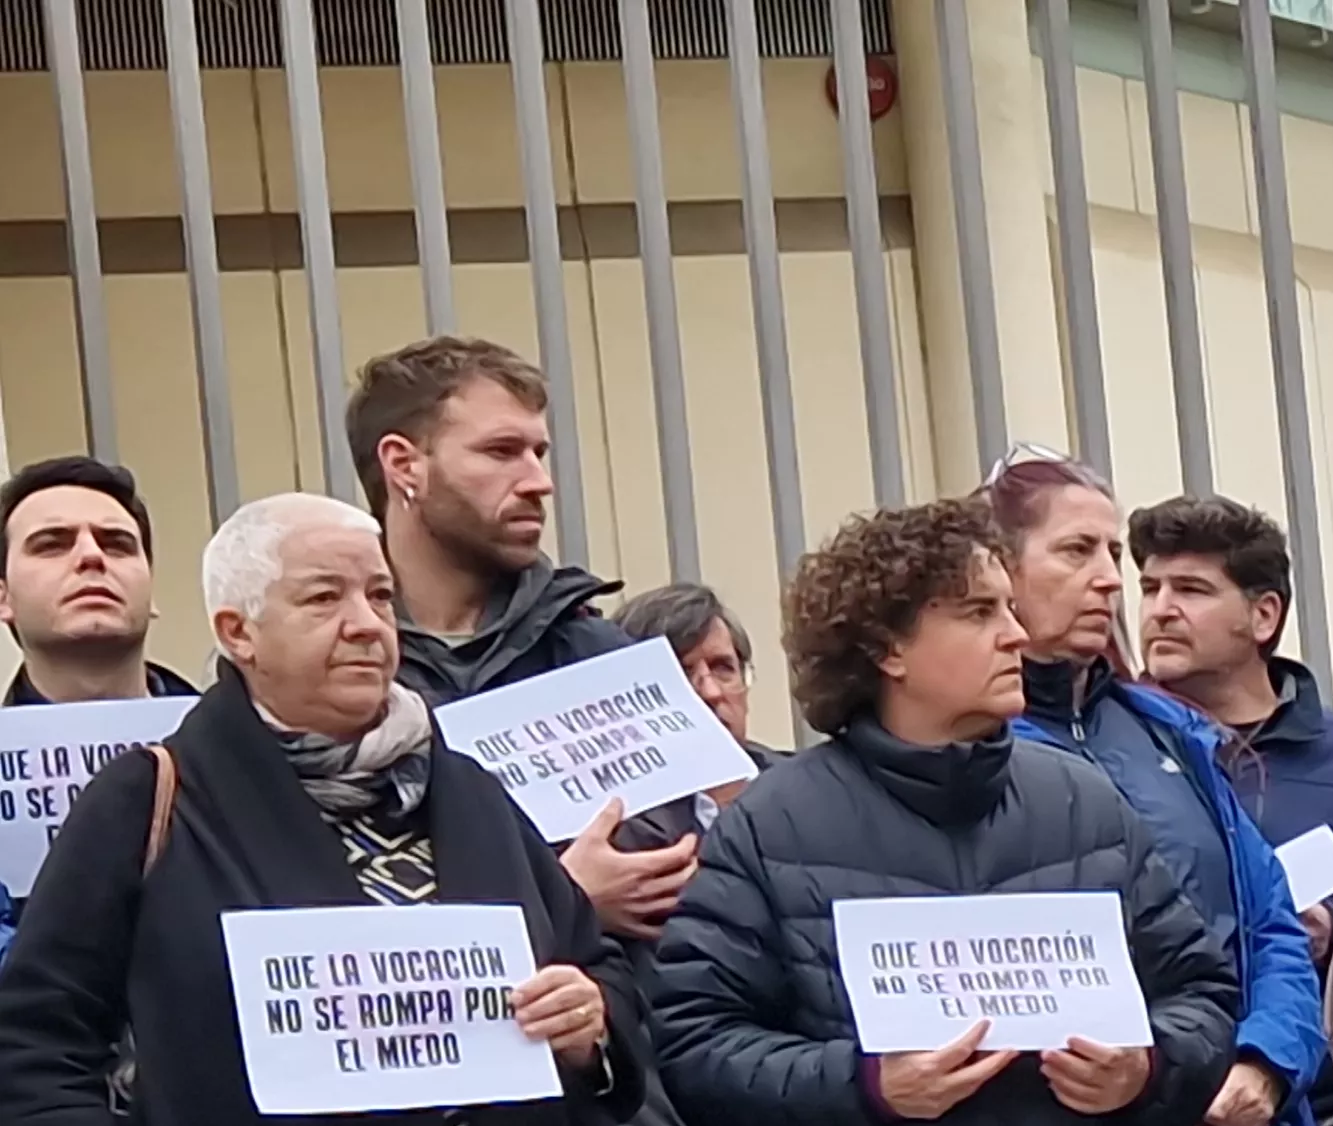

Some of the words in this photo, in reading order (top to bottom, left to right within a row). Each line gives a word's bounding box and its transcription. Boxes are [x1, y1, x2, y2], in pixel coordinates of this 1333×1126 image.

[474, 729, 525, 762] QUE
[523, 720, 558, 745] LA
[556, 682, 670, 734] VOCACIÓN
[41, 746, 70, 778] LA
[529, 751, 564, 780] SE
[562, 726, 646, 765] ROMPA
[644, 711, 696, 738] POR
[559, 775, 592, 803] EL
[592, 746, 667, 792] MIEDO
[26, 787, 58, 819] SE
[265, 955, 318, 992] QUE
[328, 953, 360, 987] LA
[370, 941, 506, 984] VOCACIÓN
[870, 941, 918, 970] QUE
[930, 940, 960, 968] LA
[968, 930, 1096, 964] VOCACIÓN
[872, 976, 906, 995] NO
[917, 974, 951, 994] SE
[959, 969, 1049, 991] ROMPA
[1060, 967, 1110, 988] POR
[264, 1000, 301, 1034] NO
[314, 997, 348, 1030] SE
[358, 988, 453, 1028] ROMPA
[466, 985, 515, 1020] POR
[941, 998, 969, 1018] EL
[979, 995, 1059, 1016] MIEDO
[335, 1038, 367, 1073] EL
[377, 1032, 461, 1069] MIEDO
